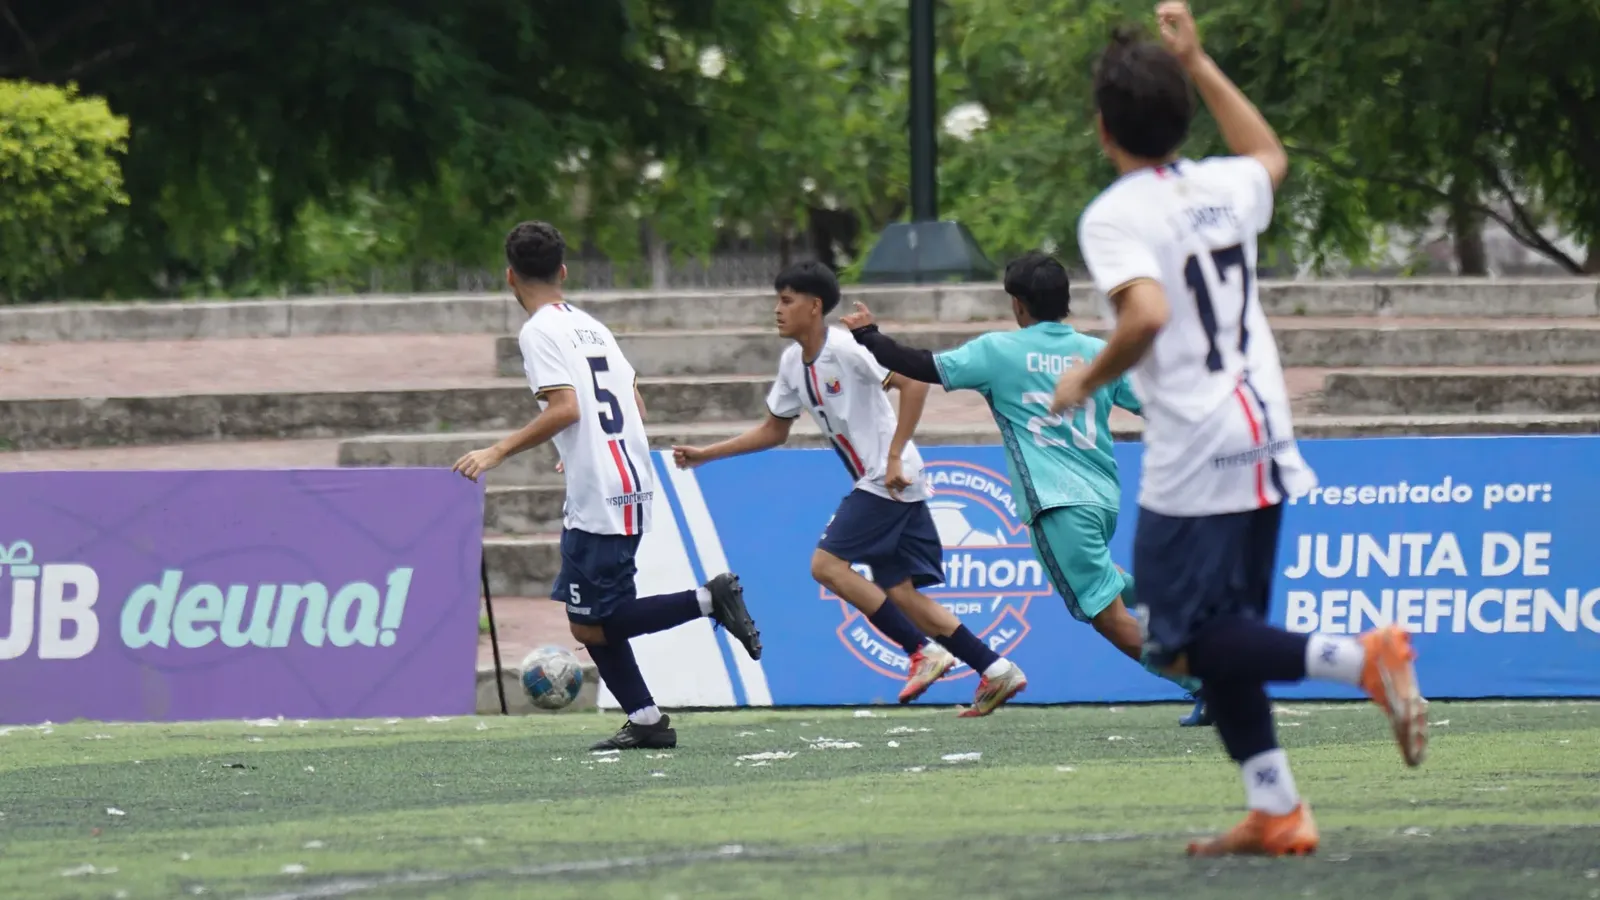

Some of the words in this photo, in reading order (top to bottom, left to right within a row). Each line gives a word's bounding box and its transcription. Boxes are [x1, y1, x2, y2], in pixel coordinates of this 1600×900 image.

[1184, 244, 1249, 373] 17
[587, 356, 625, 435] 5
[1483, 482, 1553, 510] por:
[1284, 532, 1469, 579] JUNTA
[1481, 532, 1552, 577] DE
[119, 567, 414, 649] deuna!
[569, 583, 582, 605] 5
